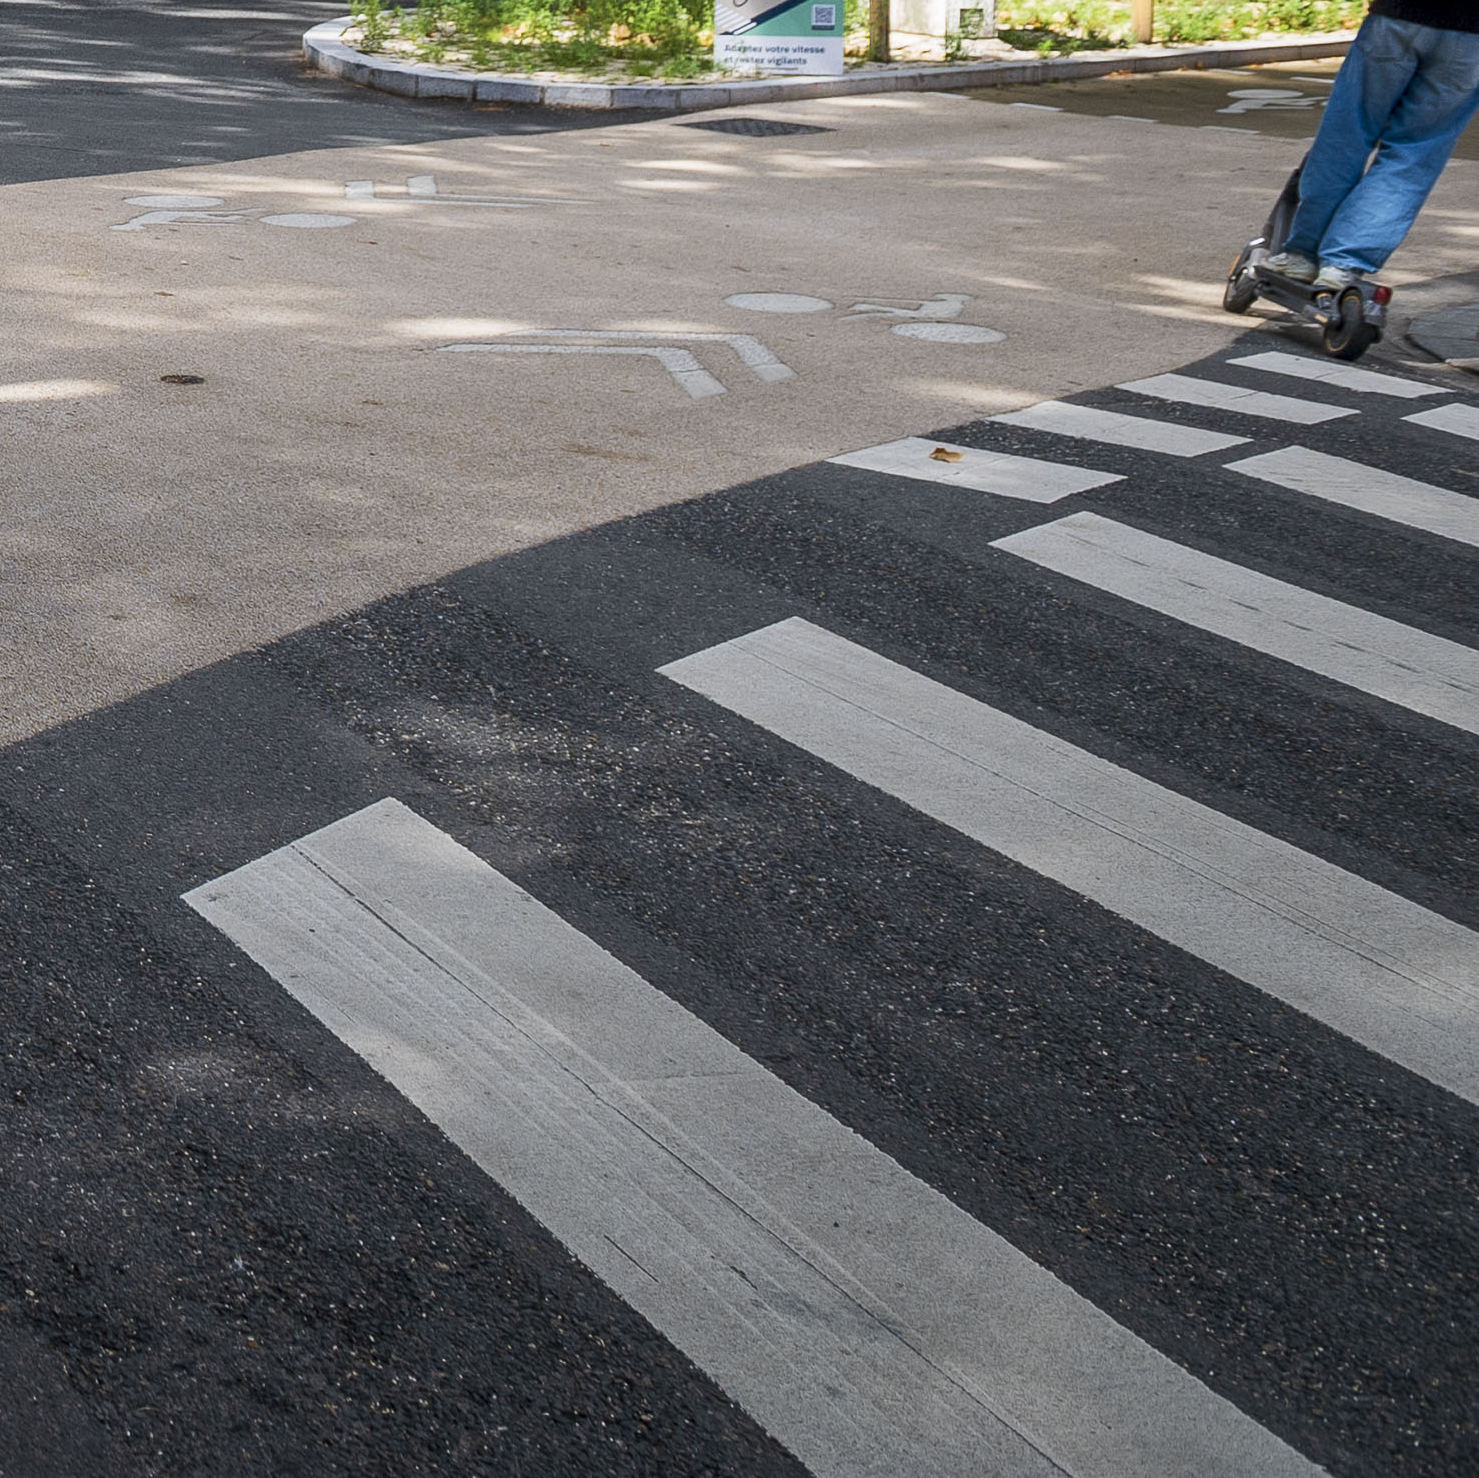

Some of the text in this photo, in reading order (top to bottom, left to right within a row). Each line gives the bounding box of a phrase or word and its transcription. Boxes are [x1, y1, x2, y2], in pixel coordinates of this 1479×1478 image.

[765, 45, 790, 54] votre
[792, 44, 826, 54] vitesse
[767, 57, 808, 67] vigilants
